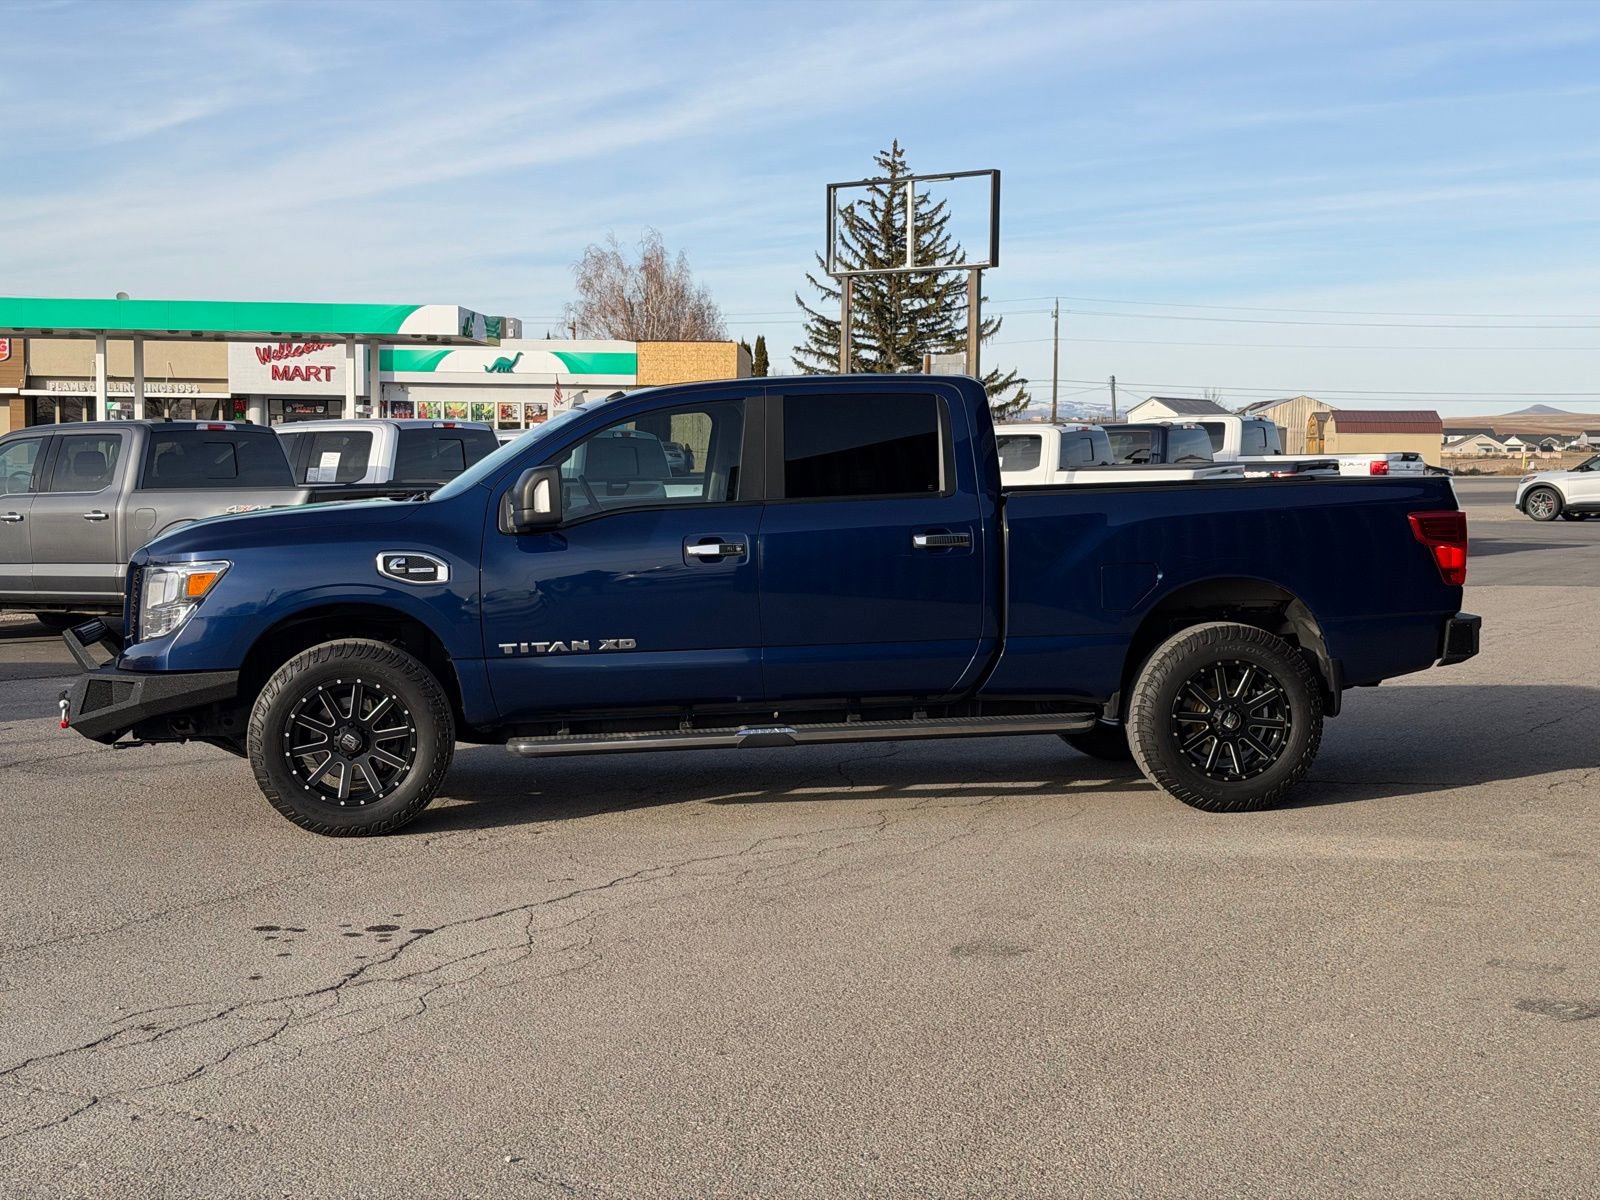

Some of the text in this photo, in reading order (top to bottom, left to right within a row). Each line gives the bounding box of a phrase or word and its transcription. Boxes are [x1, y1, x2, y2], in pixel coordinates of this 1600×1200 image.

[255, 342, 336, 365] Wellcom
[271, 365, 336, 382] MART
[49, 382, 87, 392] FLAME
[144, 383, 173, 394] INCE
[174, 384, 199, 394] 1954
[498, 639, 637, 654] TITAN XD
